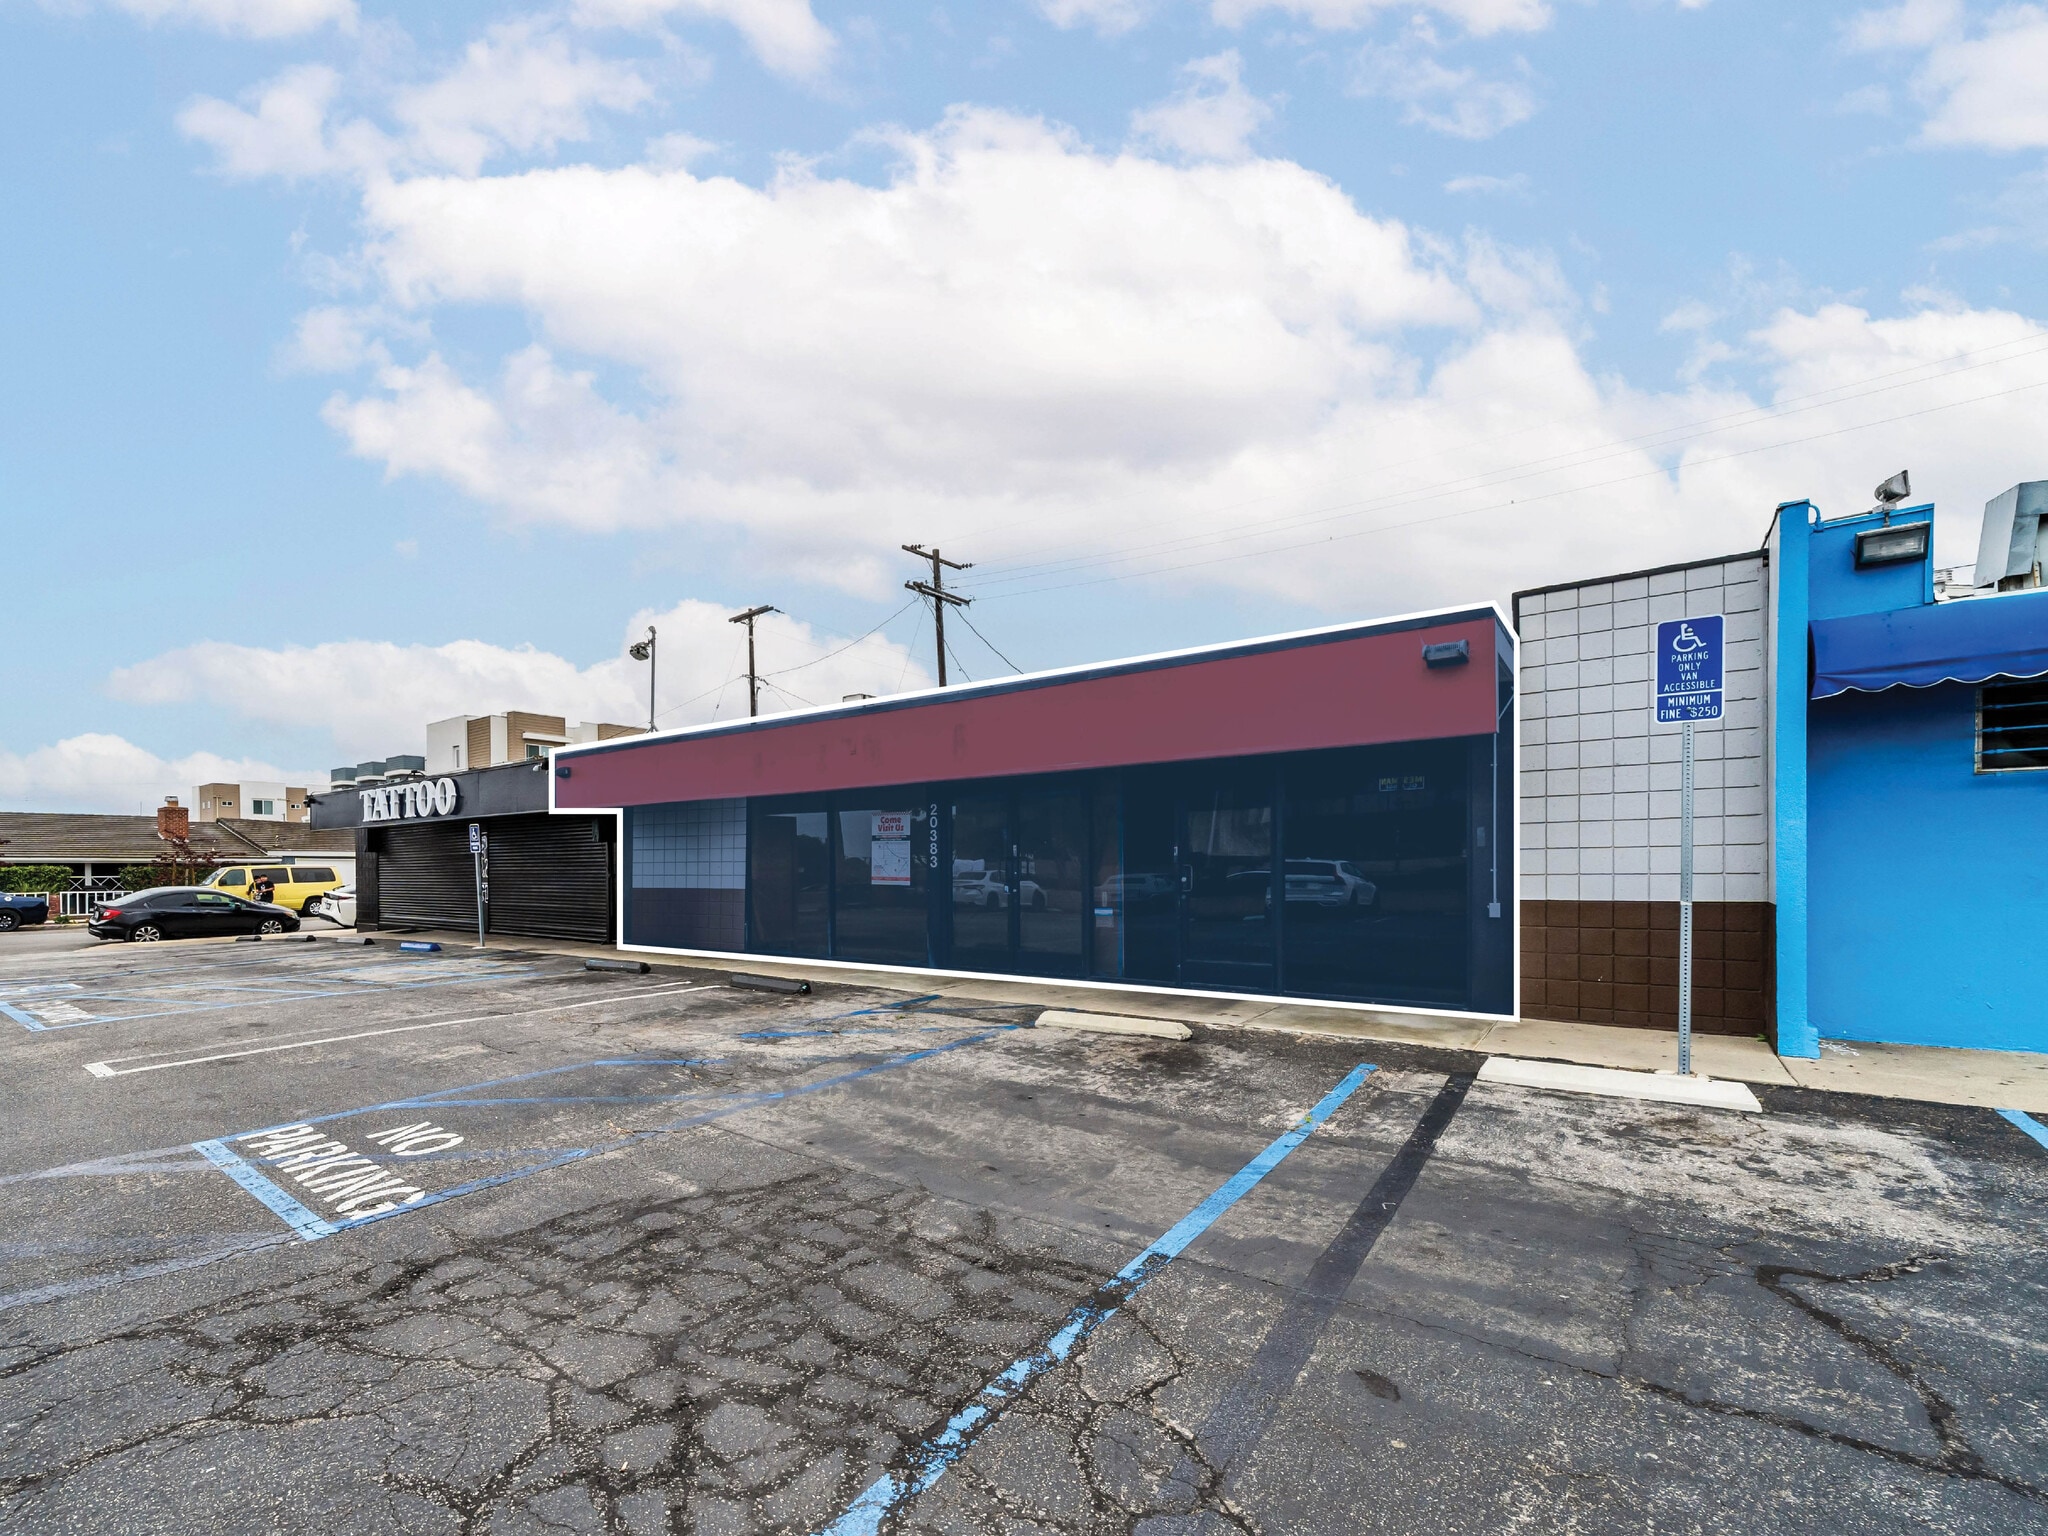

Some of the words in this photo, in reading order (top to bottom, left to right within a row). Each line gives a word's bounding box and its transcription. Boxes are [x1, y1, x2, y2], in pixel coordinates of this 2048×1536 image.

[1671, 651, 1709, 663] PARKING
[1678, 662, 1701, 672] ONLY
[1681, 671, 1698, 681] VAN
[1663, 679, 1716, 692] ACCESSIBLE
[1667, 694, 1711, 707] MINIMUM
[1660, 708, 1682, 720] FINE
[1689, 705, 1718, 718] $250
[359, 777, 457, 822] TATTOO
[880, 816, 902, 824] Come
[877, 823, 894, 832] Visit
[895, 824, 904, 832] Us
[929, 803, 938, 868] 20383
[366, 1121, 464, 1156] NO
[236, 1123, 426, 1221] PARKING
